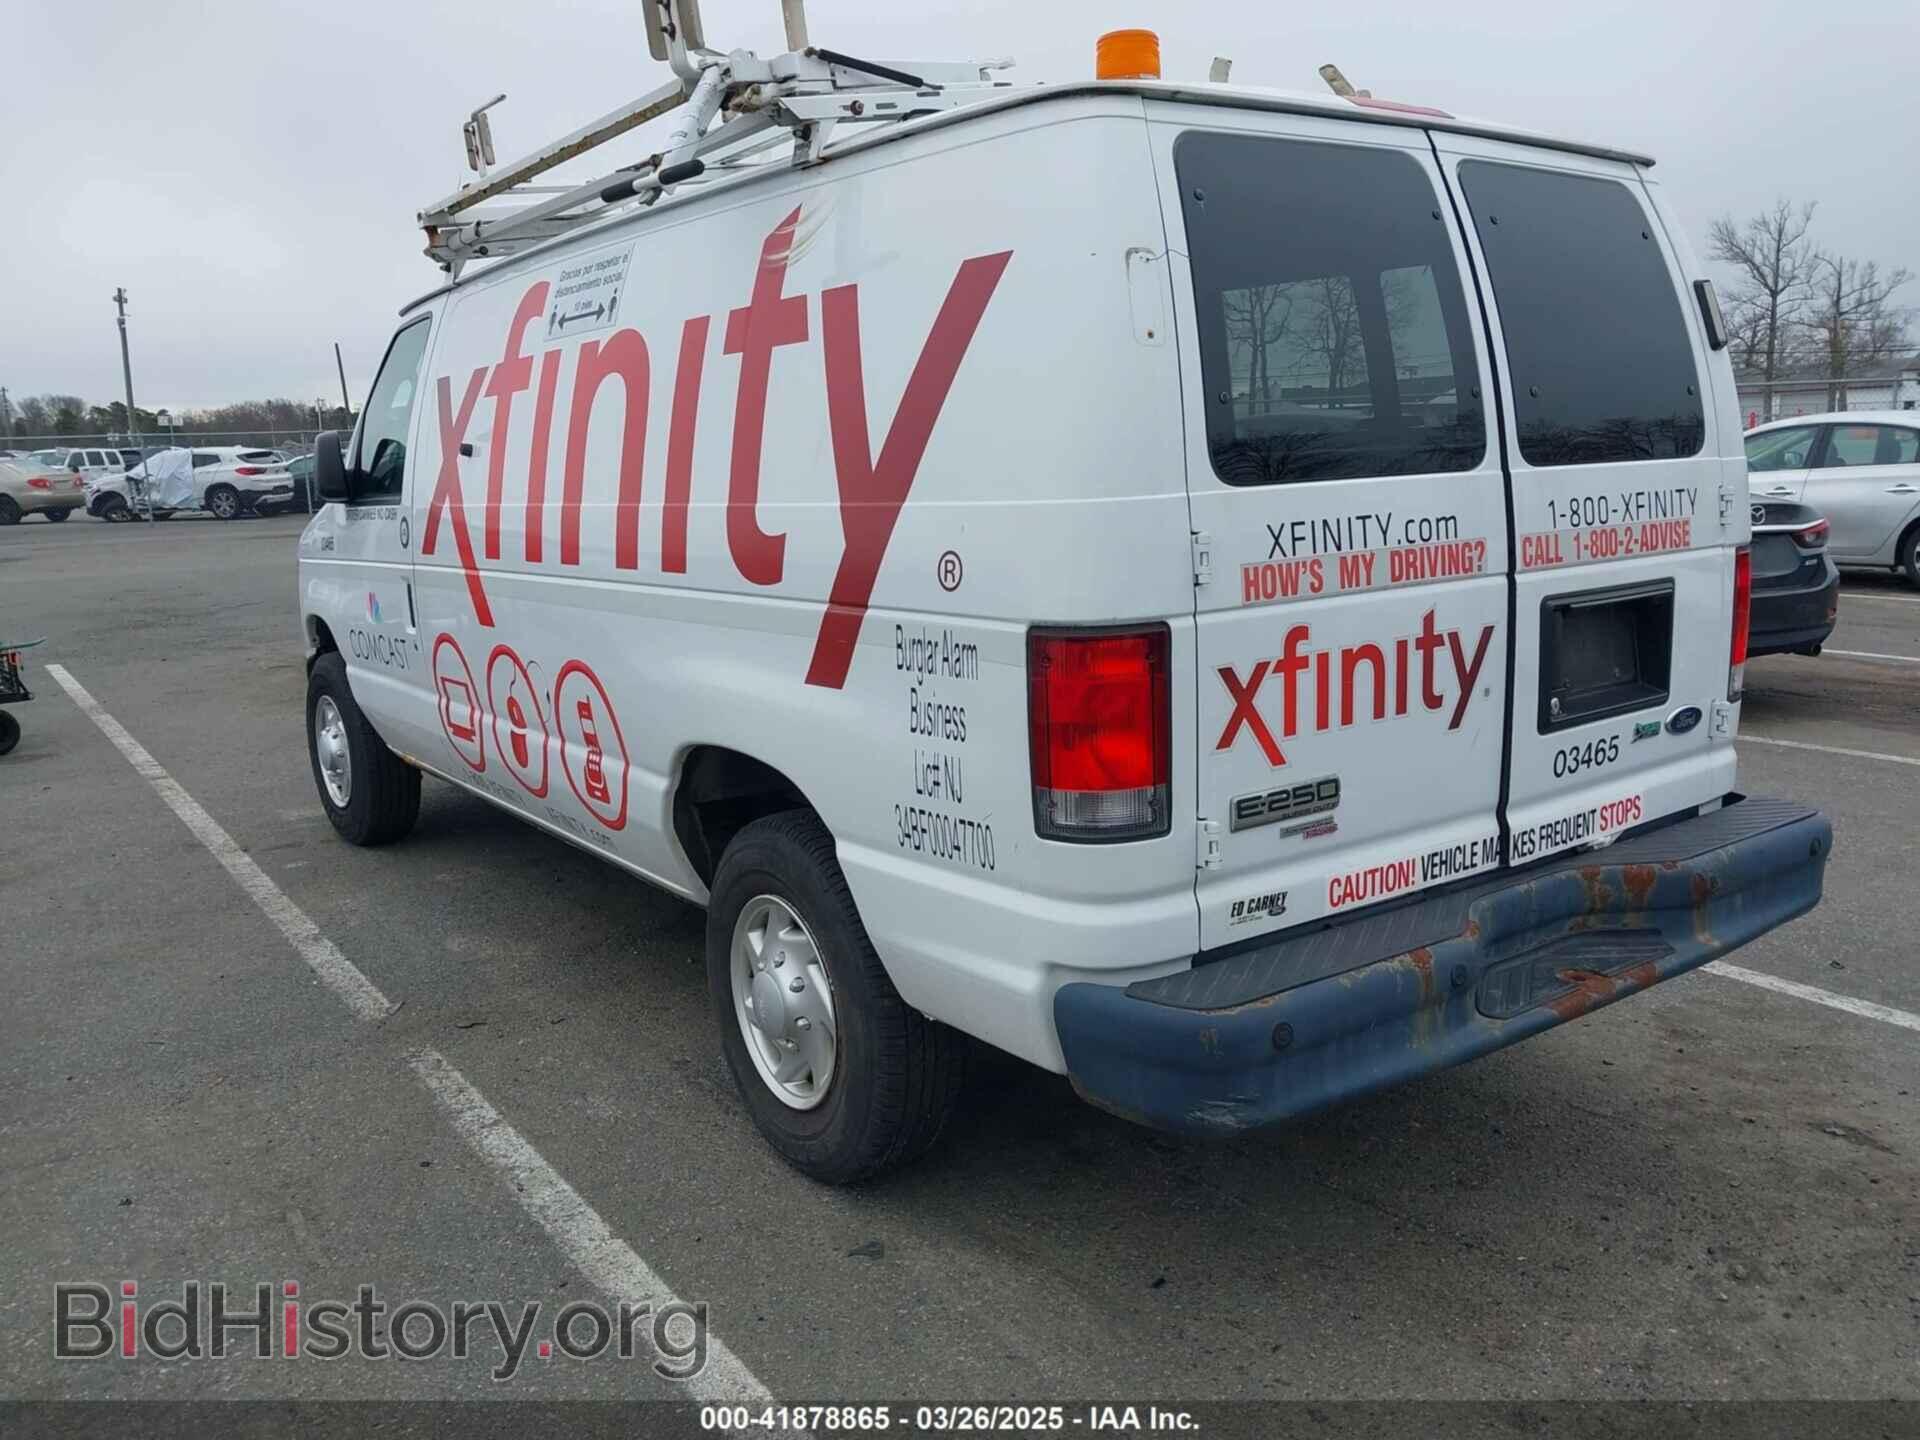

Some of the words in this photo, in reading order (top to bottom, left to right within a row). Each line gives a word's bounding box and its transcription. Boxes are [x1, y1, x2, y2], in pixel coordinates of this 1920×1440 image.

[422, 202, 1014, 689] xfinity
[1266, 512, 1458, 560] XFINITY.com
[1548, 487, 1698, 529] 1-800-XFINITY
[1242, 558, 1325, 602] HOW'S
[1339, 551, 1377, 589] MY
[1390, 540, 1486, 584] DRIVING?
[1522, 534, 1563, 567] CALL
[1573, 519, 1691, 560] 1-800-2-ADVISE
[349, 629, 410, 670] COMCAST
[895, 624, 938, 686] Burglar
[941, 629, 979, 680] Alarm
[909, 687, 967, 743] Business
[1216, 609, 1495, 767] xfinity
[913, 748, 940, 800] Lic#
[944, 754, 962, 804] NJ
[1554, 735, 1620, 778] 03465
[1328, 858, 1416, 908] CAUTION!
[1421, 841, 1479, 882] VEHICLE
[1539, 808, 1598, 851] FREQUENT
[1599, 795, 1641, 832] STOPS
[1231, 901, 1245, 918] ED
[1247, 891, 1288, 914] CARNEY
